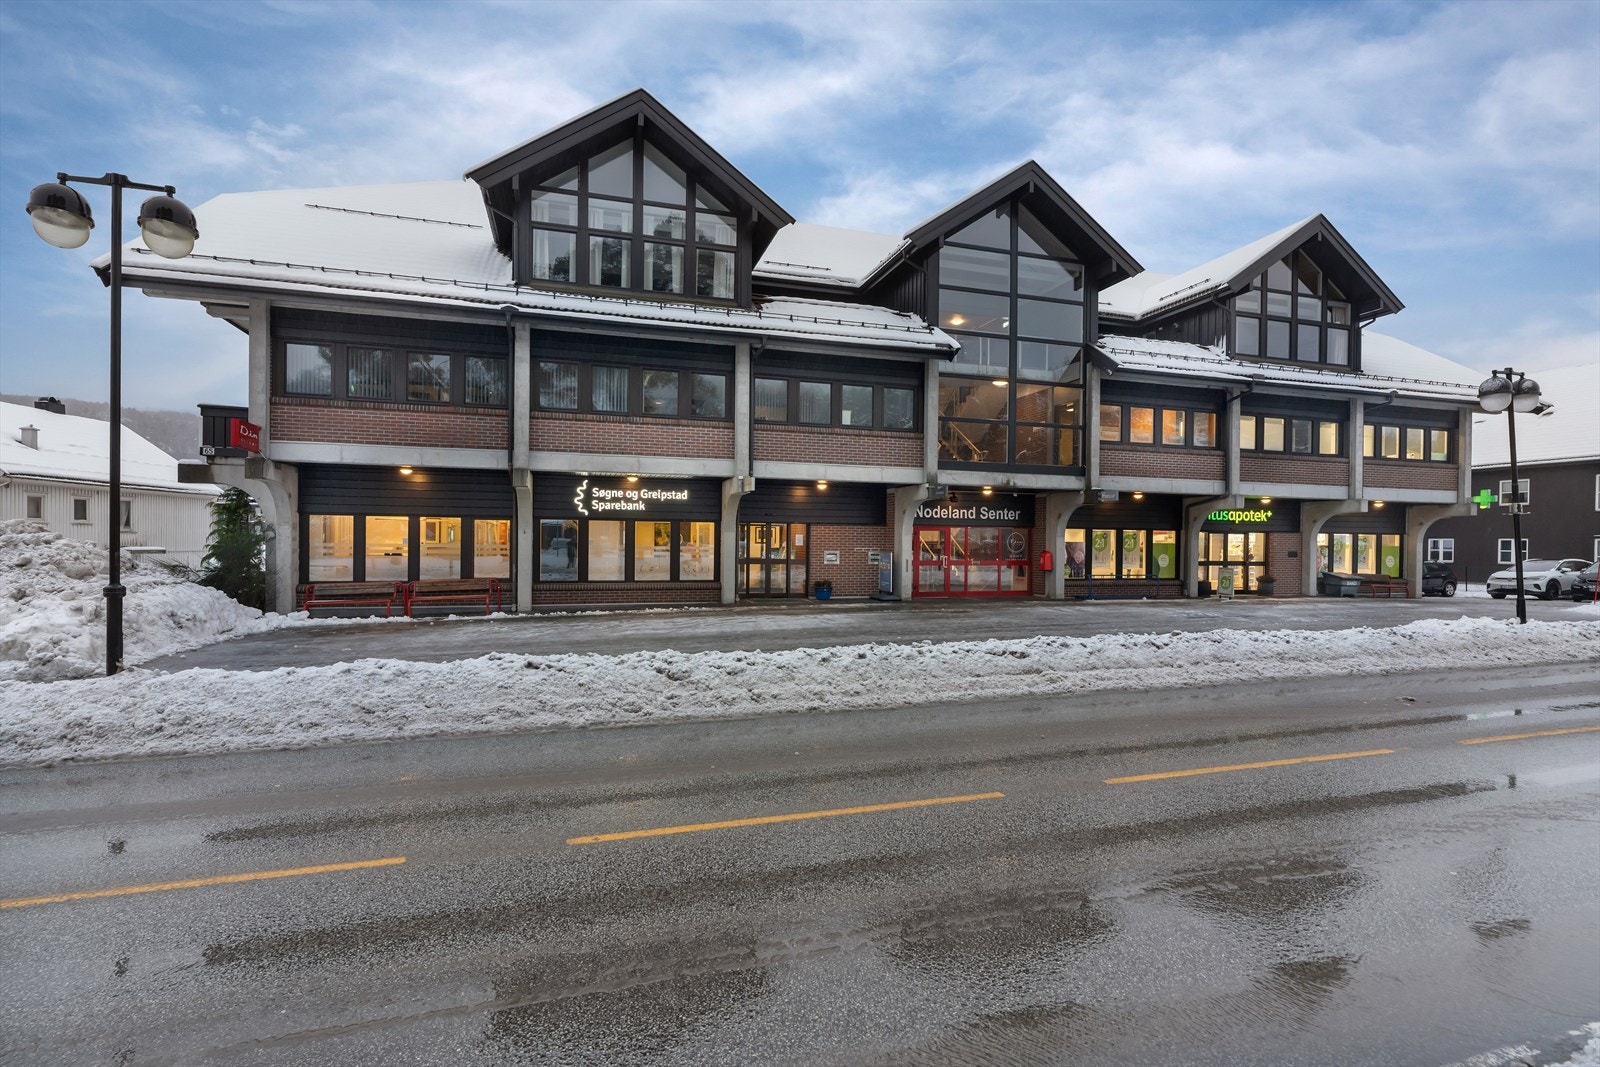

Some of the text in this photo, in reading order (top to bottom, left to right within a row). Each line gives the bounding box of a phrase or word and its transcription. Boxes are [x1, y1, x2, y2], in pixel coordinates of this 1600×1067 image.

[240, 425, 258, 439] Din
[591, 487, 688, 502] Søgne og Greipstad
[591, 500, 646, 512] Sparebank
[914, 505, 1022, 520] Nodeland Senter
